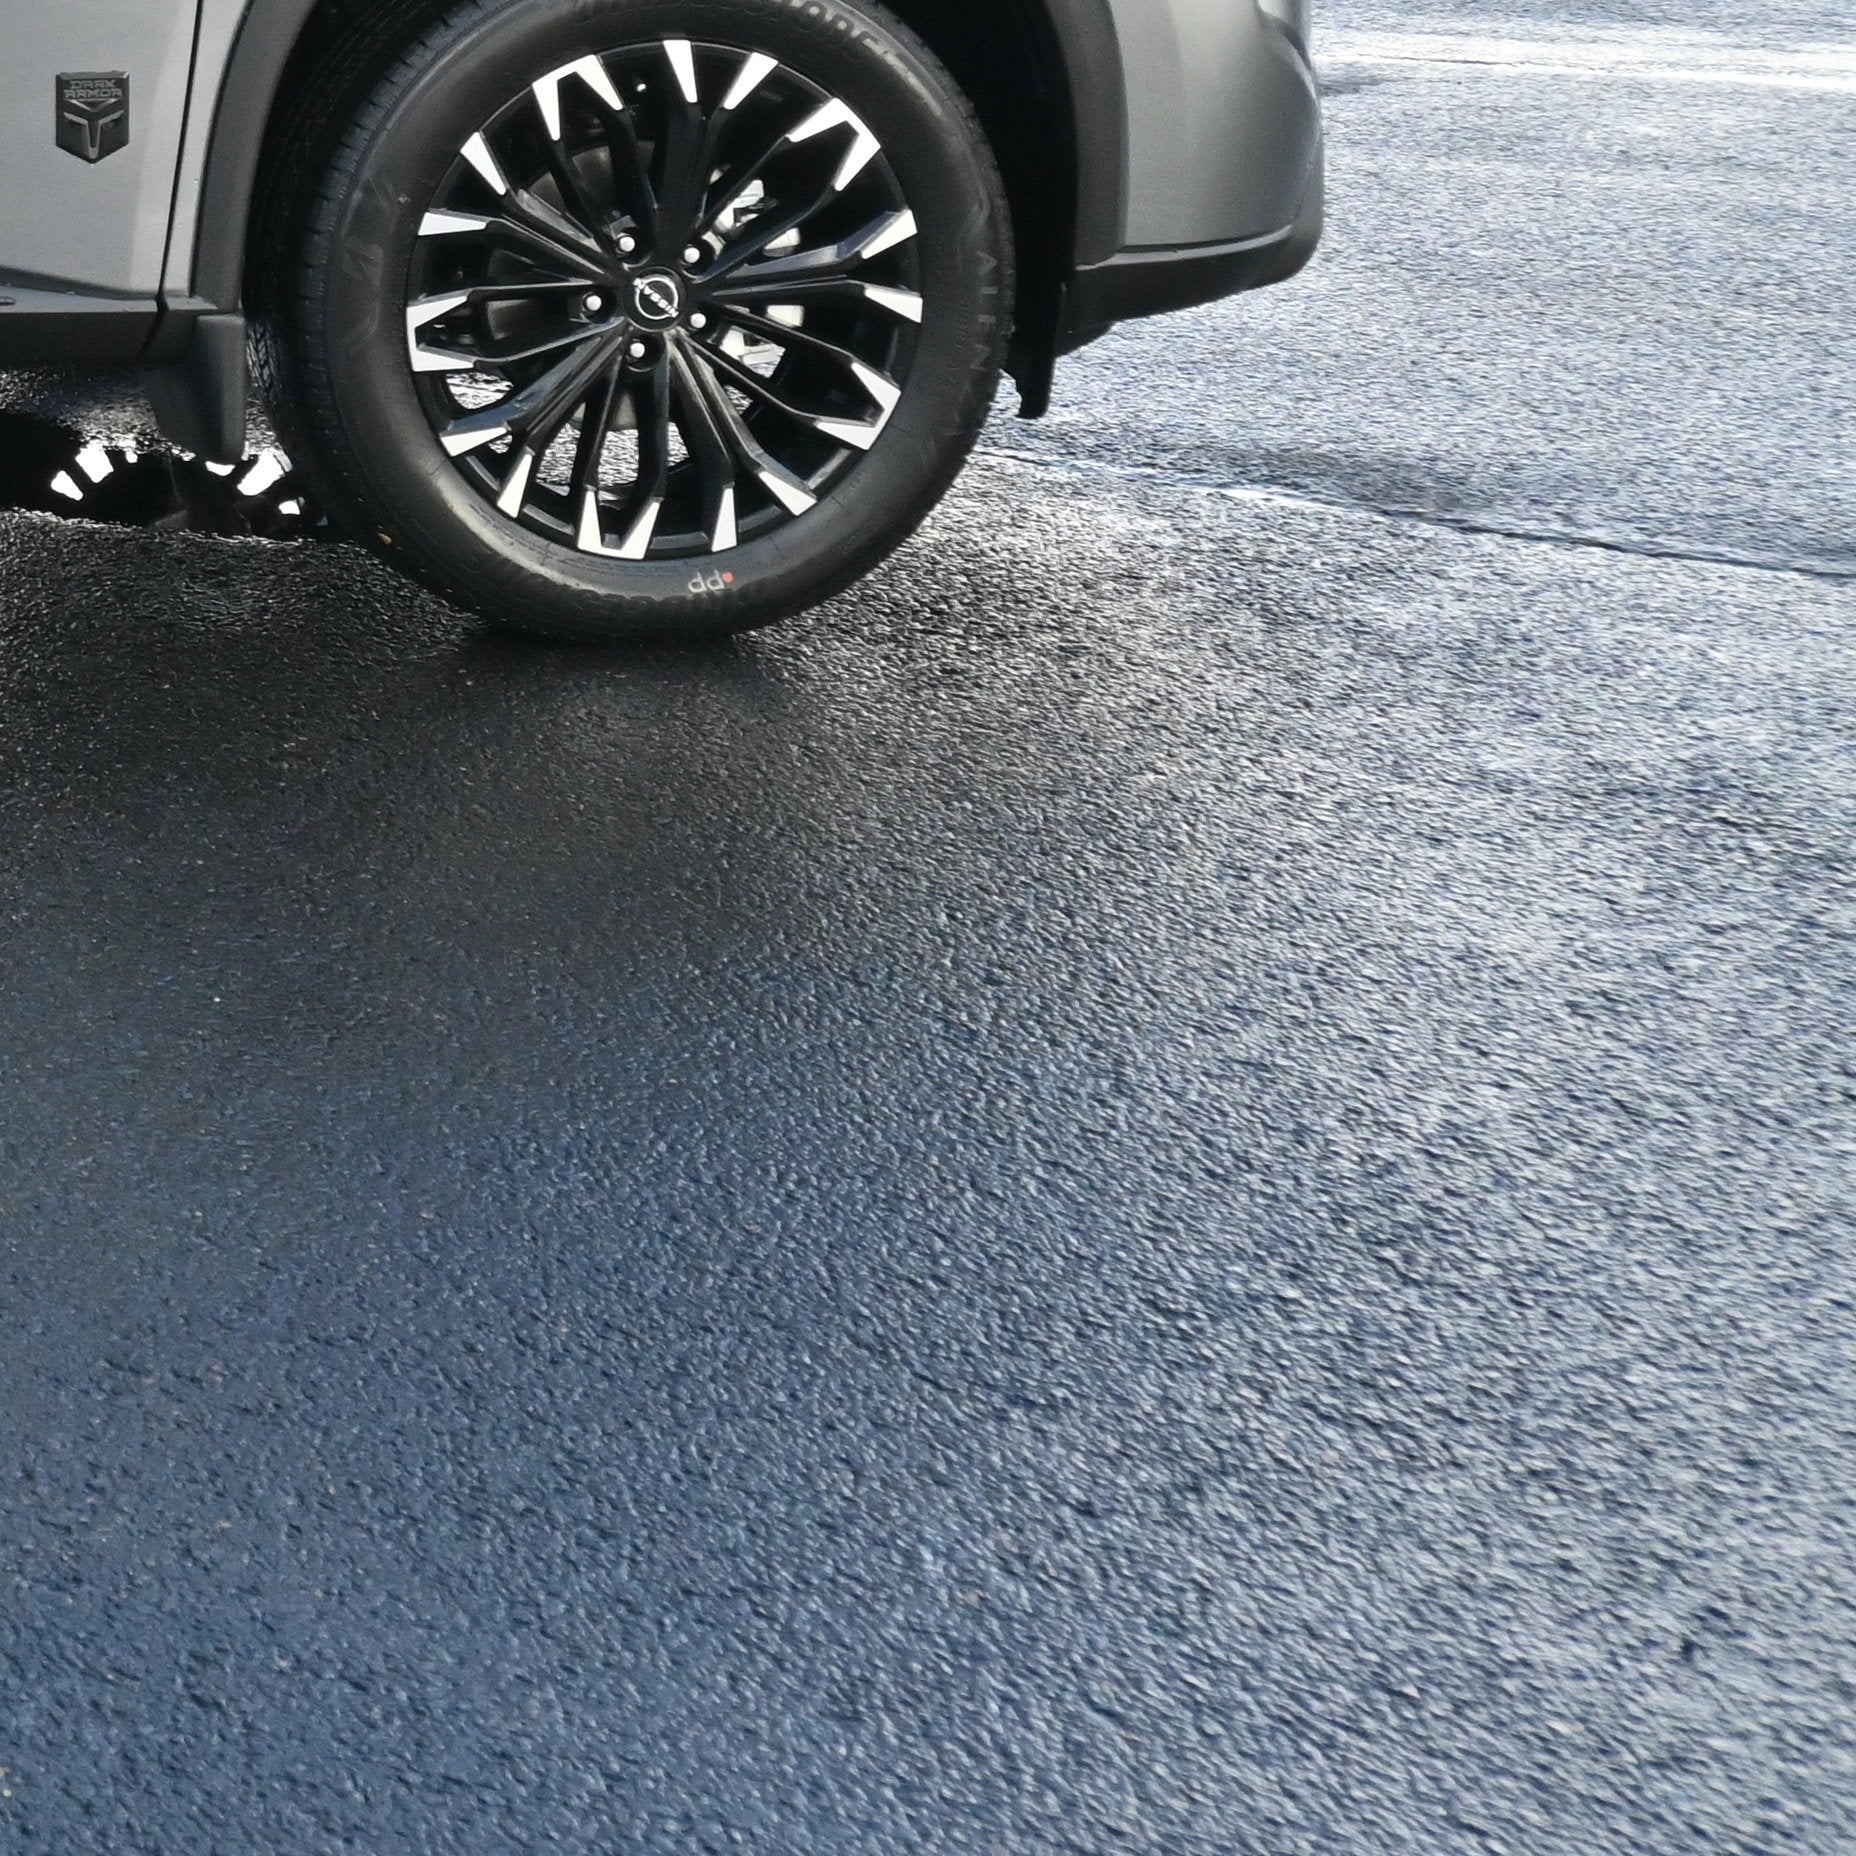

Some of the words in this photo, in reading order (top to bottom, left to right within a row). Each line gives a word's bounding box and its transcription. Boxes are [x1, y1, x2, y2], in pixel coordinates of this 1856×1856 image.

[69, 79, 117, 89] DARK
[64, 88, 123, 99] ARMOR
[633, 277, 679, 318] NISSAN
